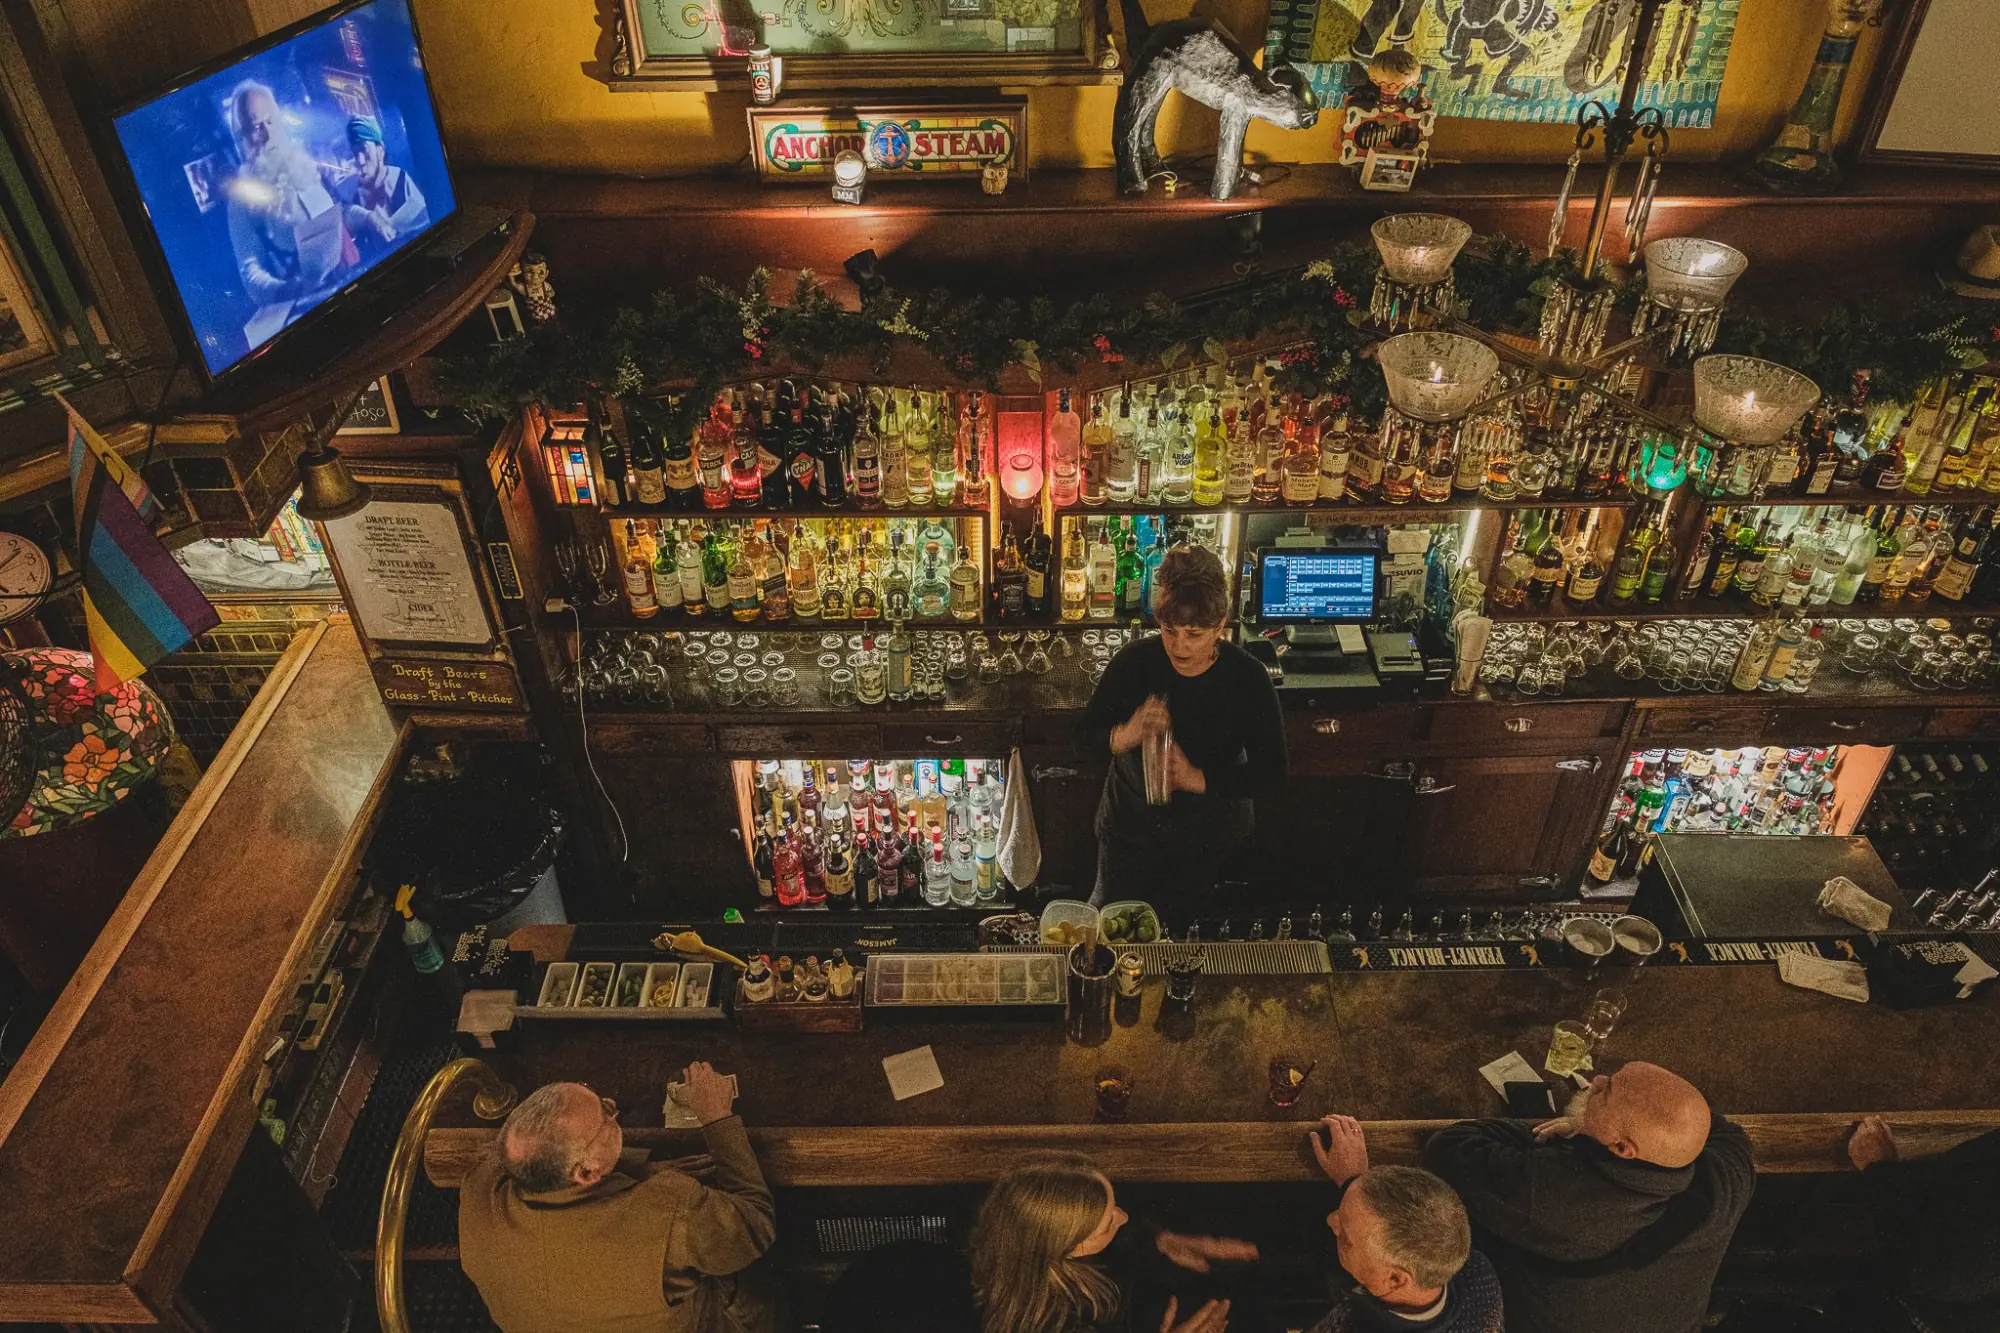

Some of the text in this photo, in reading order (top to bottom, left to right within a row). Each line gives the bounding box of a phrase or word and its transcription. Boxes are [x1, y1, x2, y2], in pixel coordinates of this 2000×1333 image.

[773, 132, 1006, 159] ANCHOR STEAM
[837, 190, 854, 199] MM
[364, 516, 420, 526] DRAFT BEER
[377, 559, 436, 569] BOTTLE BEER
[408, 603, 434, 612] CIDER
[392, 664, 488, 681] Draft Beers
[428, 679, 462, 690] by the
[384, 688, 419, 701] Glass
[428, 689, 457, 702] Pint
[467, 691, 513, 705] Pitcher
[857, 937, 898, 948] JAMESON
[1387, 946, 1507, 966] FERNET-BRANCA
